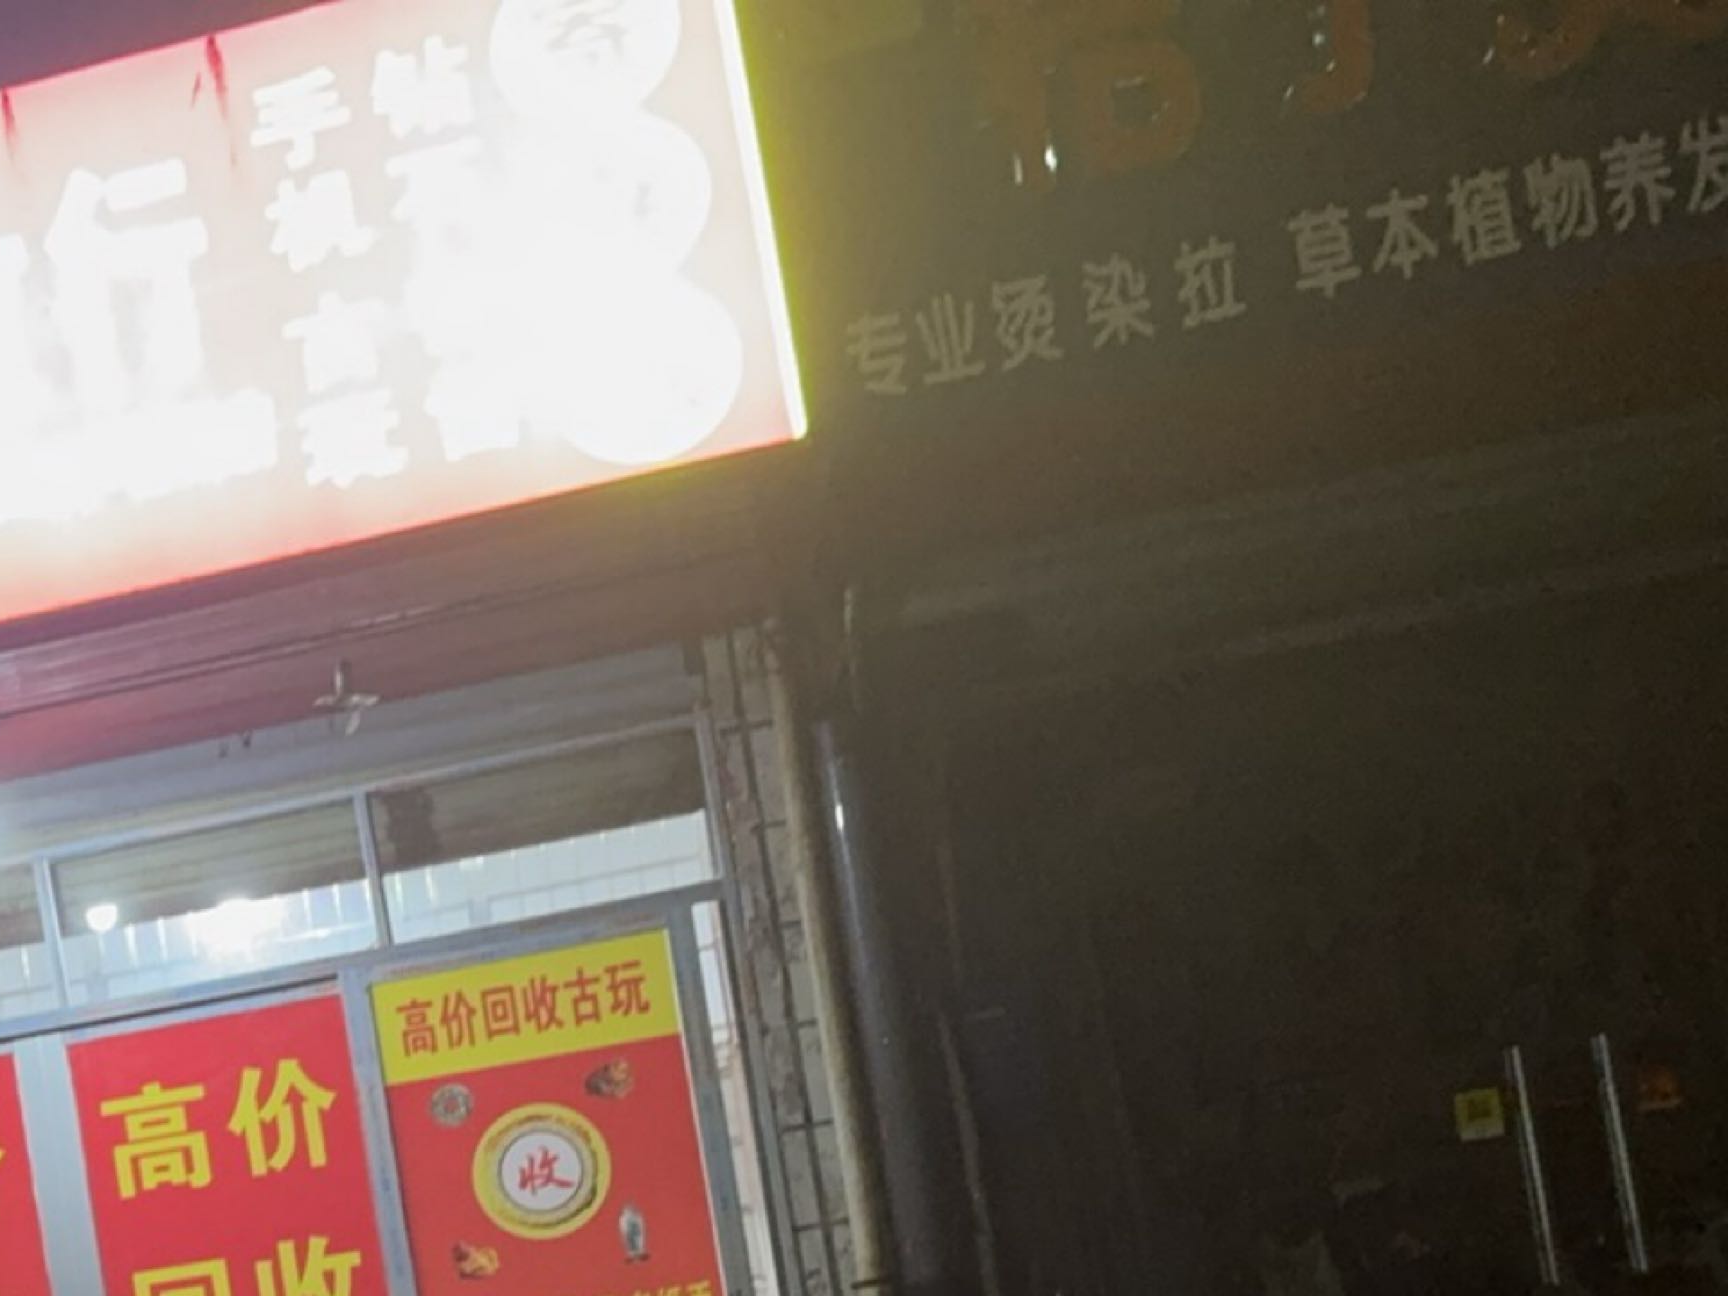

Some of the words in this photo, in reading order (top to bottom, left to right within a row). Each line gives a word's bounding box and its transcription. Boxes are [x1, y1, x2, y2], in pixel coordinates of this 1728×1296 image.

[846, 236, 1247, 397] 专业烫染拉
[396, 959, 650, 1058] 高价回收古玩
[100, 1058, 337, 1200] 高价
[518, 1145, 572, 1195] 收
